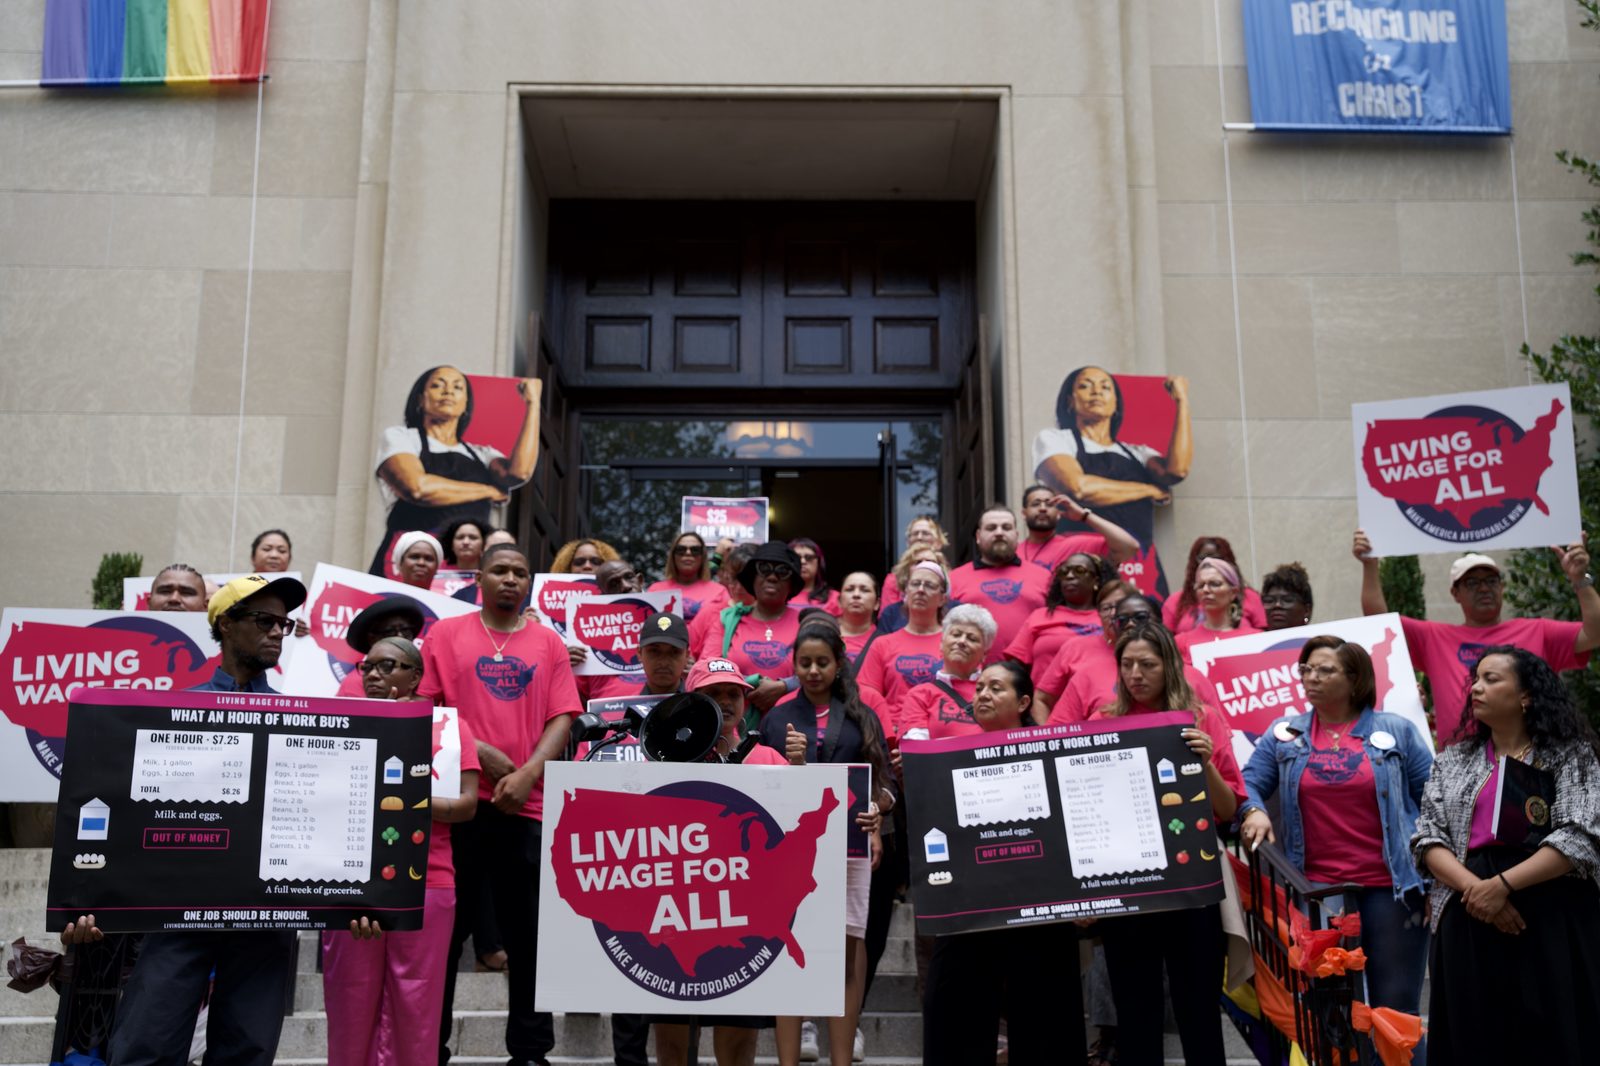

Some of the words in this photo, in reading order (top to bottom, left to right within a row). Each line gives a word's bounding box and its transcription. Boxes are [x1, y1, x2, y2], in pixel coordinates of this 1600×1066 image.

[1337, 80, 1424, 119] CHRIST
[1373, 431, 1472, 467] LIVING
[1379, 457, 1449, 484] WAGE
[1454, 449, 1504, 473] FOR
[1435, 471, 1505, 505] ALL
[706, 508, 727, 524] $25
[1405, 506, 1426, 528] MAKE
[1423, 522, 1459, 541] AMERICA
[1460, 519, 1510, 541] AFFORDABLE
[1508, 503, 1526, 524] NOW
[718, 526, 736, 538] ALL
[740, 526, 755, 539] DC
[543, 589, 593, 601] LIVING
[544, 600, 566, 610] WA
[321, 603, 364, 624] LIV
[579, 611, 634, 629] LIVING
[582, 626, 621, 638] WAGE
[612, 634, 641, 651] AL
[13, 649, 140, 683] LIVING
[479, 663, 512, 672] LIVING
[496, 678, 519, 687] ALL
[217, 696, 246, 705] LIVING
[249, 698, 272, 706] WAGE
[275, 699, 291, 707] FOR
[294, 700, 309, 708] ALL
[1223, 686, 1294, 717] WAGE
[171, 708, 205, 722] WHAT
[207, 710, 225, 723] AN
[227, 711, 262, 725] HOUR
[264, 712, 280, 726] OF
[282, 714, 317, 727] WORK
[320, 715, 350, 729] BUYS
[150, 733, 171, 743] ONE
[174, 733, 203, 744] HOUR
[212, 735, 239, 745] $7.25
[1007, 731, 1030, 740] LIVING
[1033, 729, 1051, 737] WAGE
[1053, 727, 1067, 735] FOR
[286, 738, 305, 748] ONE
[308, 738, 335, 749] HOUR
[343, 740, 361, 751] $25
[974, 748, 1001, 760] WHAT
[1003, 745, 1017, 757] AN
[1018, 742, 1047, 754] HOUR
[1048, 740, 1061, 751] OF
[1062, 737, 1092, 749] WORK
[1094, 733, 1120, 745] BUYS
[35, 740, 59, 768] MAKE
[1070, 757, 1086, 766] ONE
[1088, 754, 1111, 764] HOUR
[1118, 751, 1133, 761] $25
[170, 759, 193, 768] gallon
[222, 760, 243, 768] $4.07
[221, 771, 242, 779] $2.19
[963, 770, 979, 779] ONE
[981, 767, 1004, 777] HOUR
[1011, 763, 1033, 773] $7.25
[154, 810, 177, 819] Milk
[179, 810, 197, 819] and
[199, 812, 223, 821] eggs.
[965, 812, 980, 820] TOTAL
[152, 833, 171, 843] OUT
[175, 833, 186, 843] OF
[189, 833, 221, 843] MONEY
[980, 830, 997, 839] Milk
[999, 828, 1013, 837] and
[1014, 828, 1034, 837] eggs.
[570, 822, 709, 864] LIVING
[982, 849, 997, 858] OUT
[999, 847, 1008, 856] OF
[1011, 845, 1036, 855] MONEY
[269, 858, 288, 866] TOTAL
[343, 860, 363, 868] $23.13
[1078, 857, 1094, 865] TOTAL
[575, 862, 674, 893] WAGE
[683, 856, 750, 884] FOR
[1088, 879, 1100, 888] full
[1101, 878, 1120, 887] week
[1121, 877, 1128, 885] of
[1129, 874, 1164, 885] groceries.
[274, 885, 289, 894] full
[290, 886, 312, 894] week
[313, 886, 323, 894] of
[324, 887, 364, 896] groceries.
[649, 889, 748, 934] ALL
[1020, 908, 1035, 917] ONE
[1036, 906, 1050, 915] JOB
[1051, 903, 1080, 913] SHOULD
[1081, 901, 1091, 910] BE
[1091, 898, 1124, 909] ENOUGH.
[184, 911, 201, 920] ONE
[203, 911, 220, 920] JOB
[222, 911, 257, 920] SHOULD
[259, 911, 271, 920] BE
[273, 911, 310, 920] ENOUGH.
[605, 935, 633, 968] MAKE
[629, 963, 675, 995] AMERICA
[679, 966, 751, 996] AFFORDABLE
[748, 945, 773, 972] NOW
